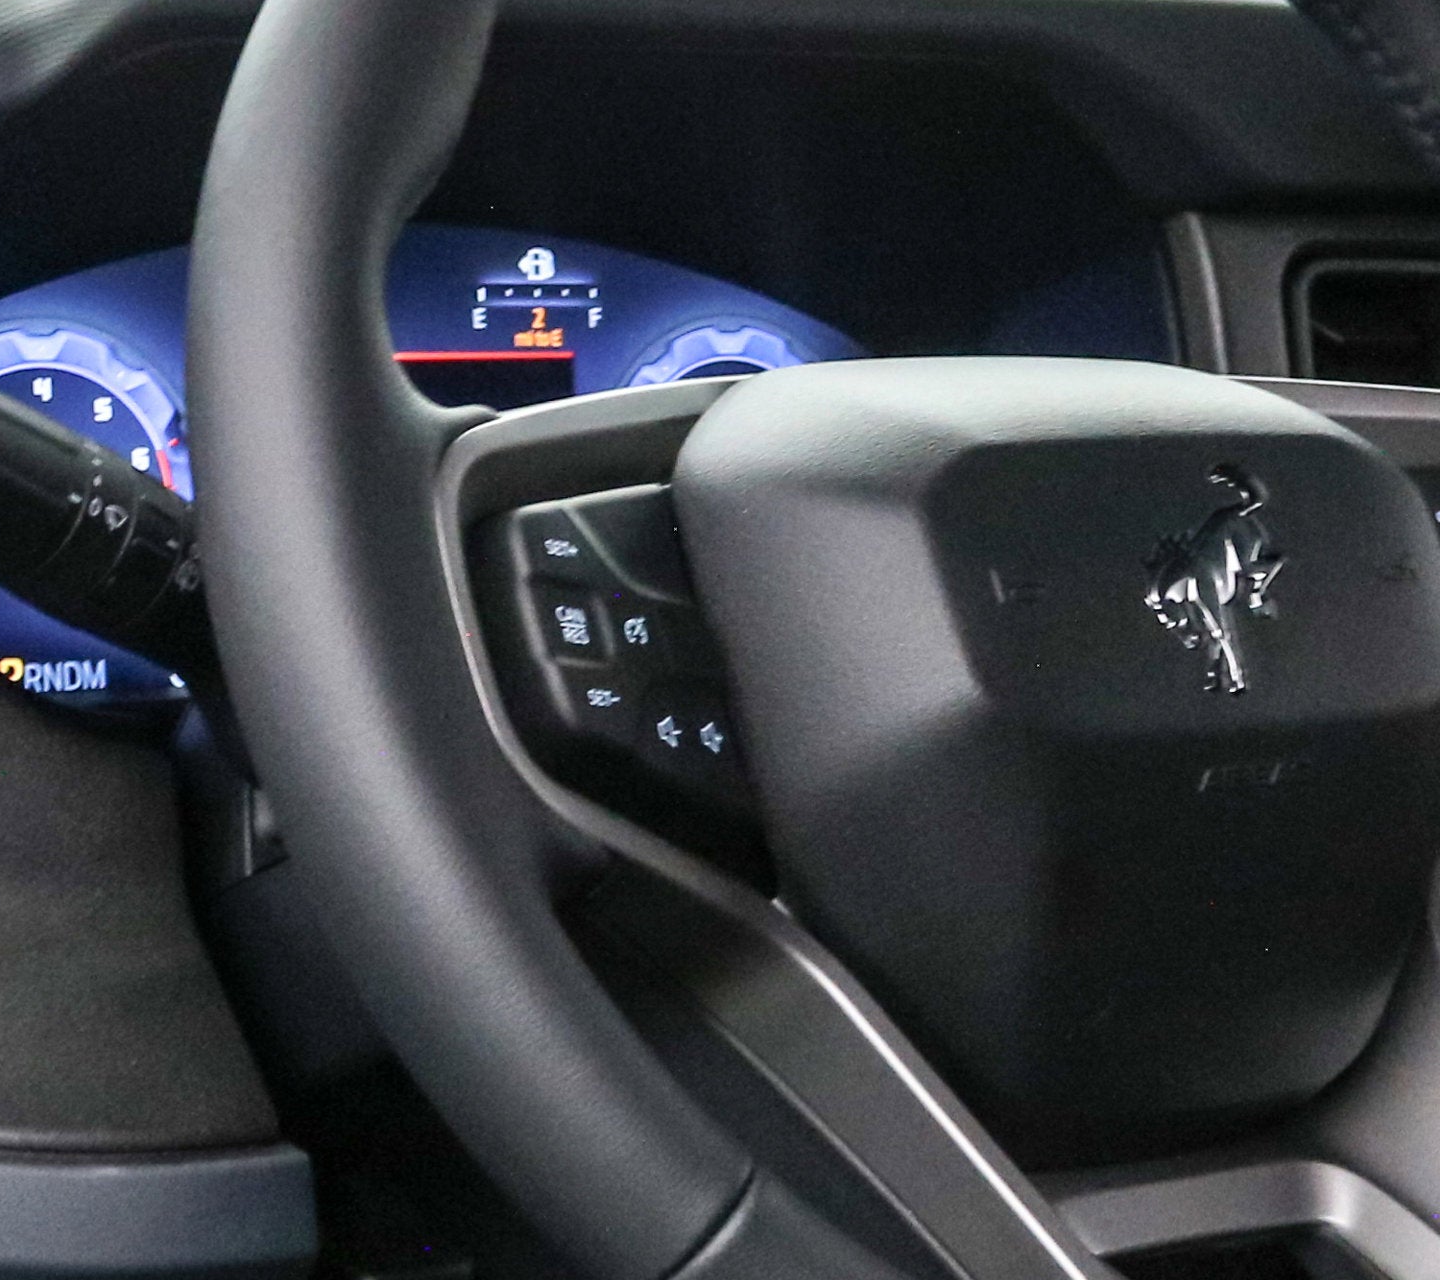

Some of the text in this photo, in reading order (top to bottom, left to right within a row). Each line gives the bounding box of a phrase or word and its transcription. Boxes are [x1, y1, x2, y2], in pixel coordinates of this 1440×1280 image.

[471, 306, 488, 330] E
[531, 307, 547, 329] 2
[587, 306, 603, 329] F
[31, 377, 53, 402] 4
[92, 396, 113, 422] 5
[130, 446, 150, 471] 6
